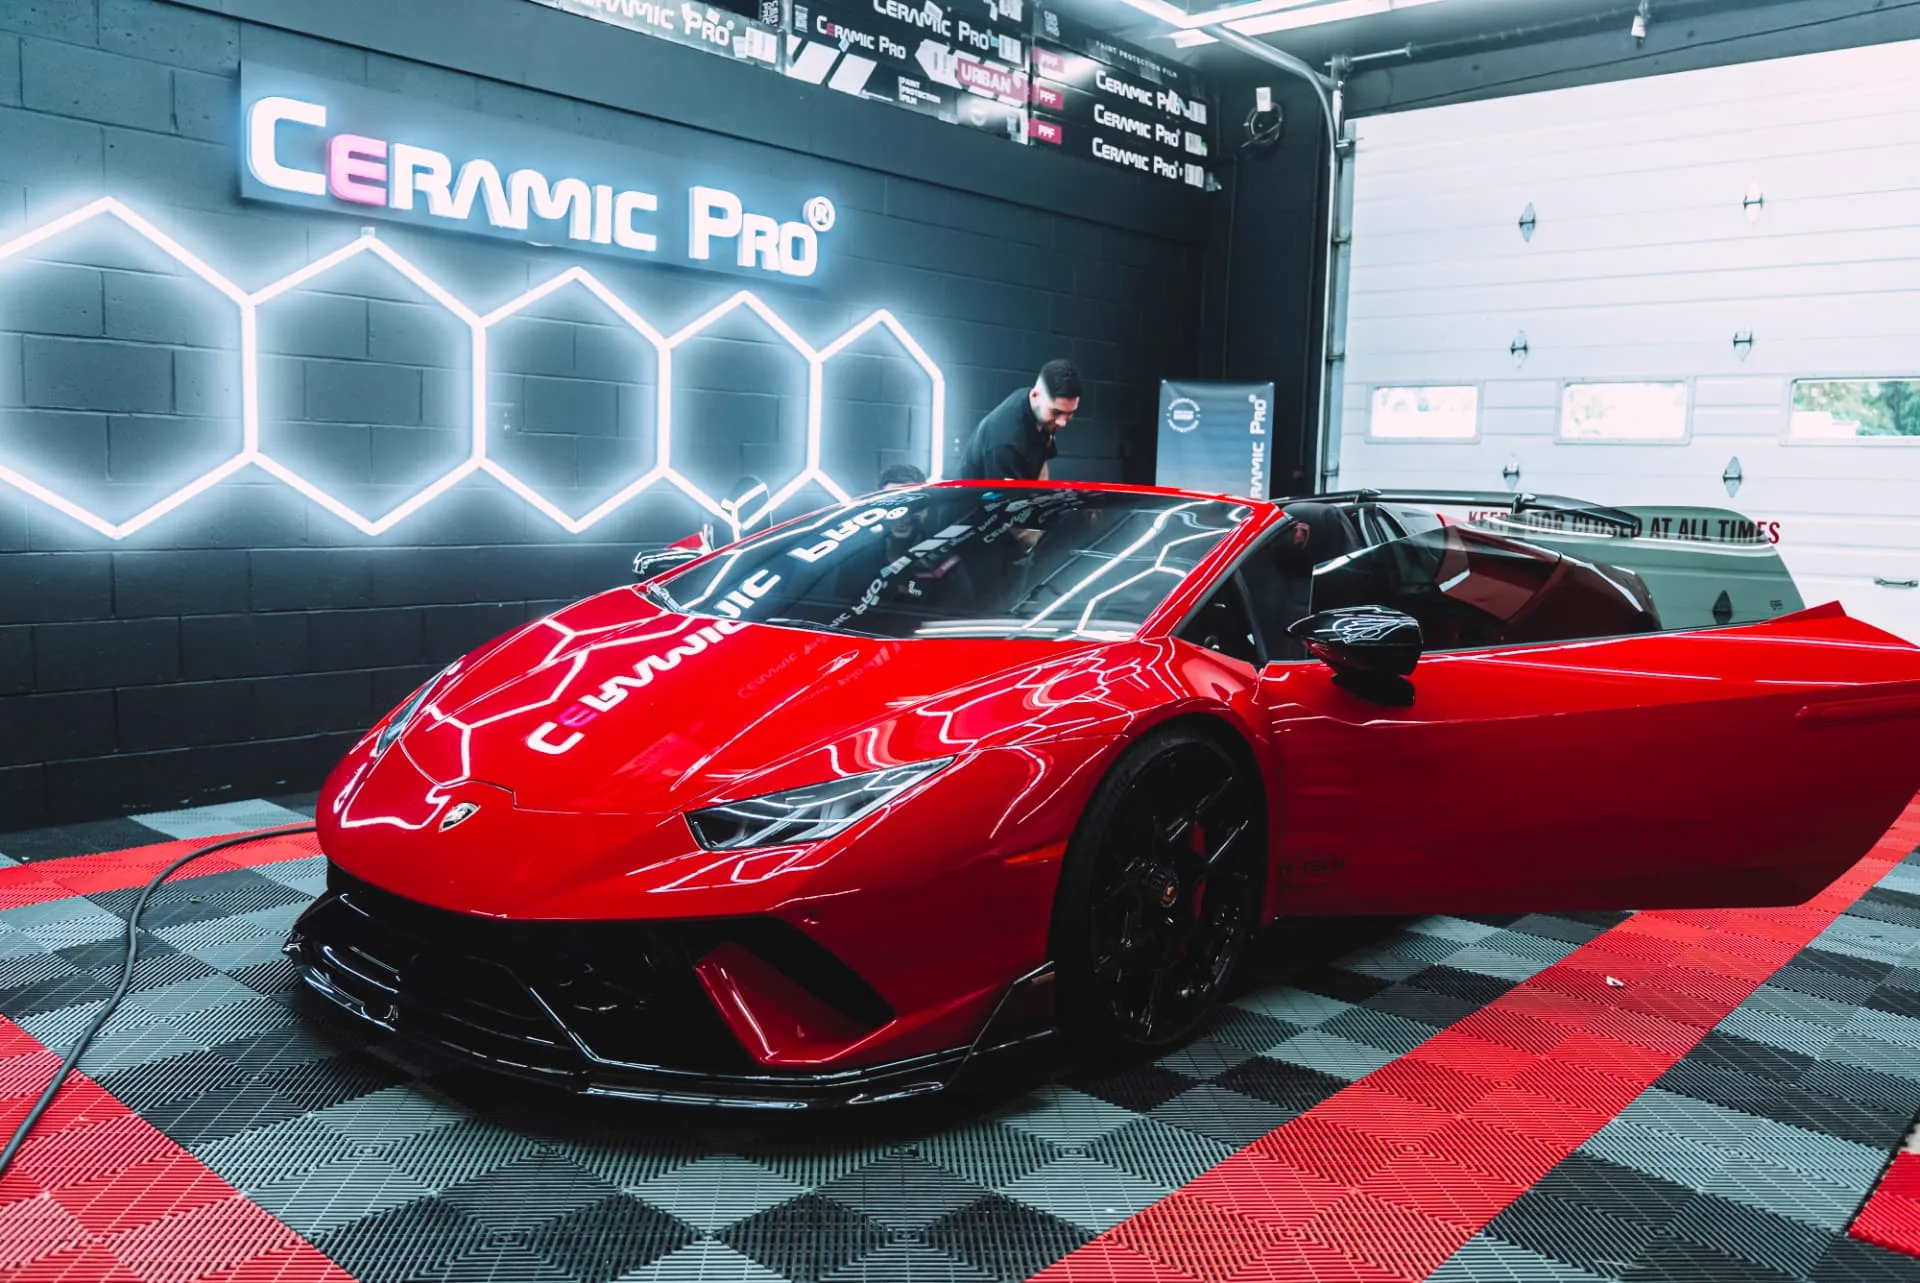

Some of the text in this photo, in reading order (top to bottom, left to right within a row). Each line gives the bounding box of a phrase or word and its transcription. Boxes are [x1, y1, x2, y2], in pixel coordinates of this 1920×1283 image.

[816, 15, 876, 50] CERAMIC
[879, 35, 906, 60] PRO
[961, 63, 1012, 94] URBAN
[1096, 70, 1153, 107] CERAMIC
[1038, 124, 1056, 140] PPF
[1094, 103, 1179, 148] CERAMIC PRO
[248, 96, 657, 251] CERAMIC
[1092, 137, 1178, 179] CERAMIC PRO
[1250, 442, 1265, 498] RAMIC
[1650, 517, 1673, 539] AT
[1677, 518, 1711, 541] ALL
[1718, 519, 1781, 545] TIMES
